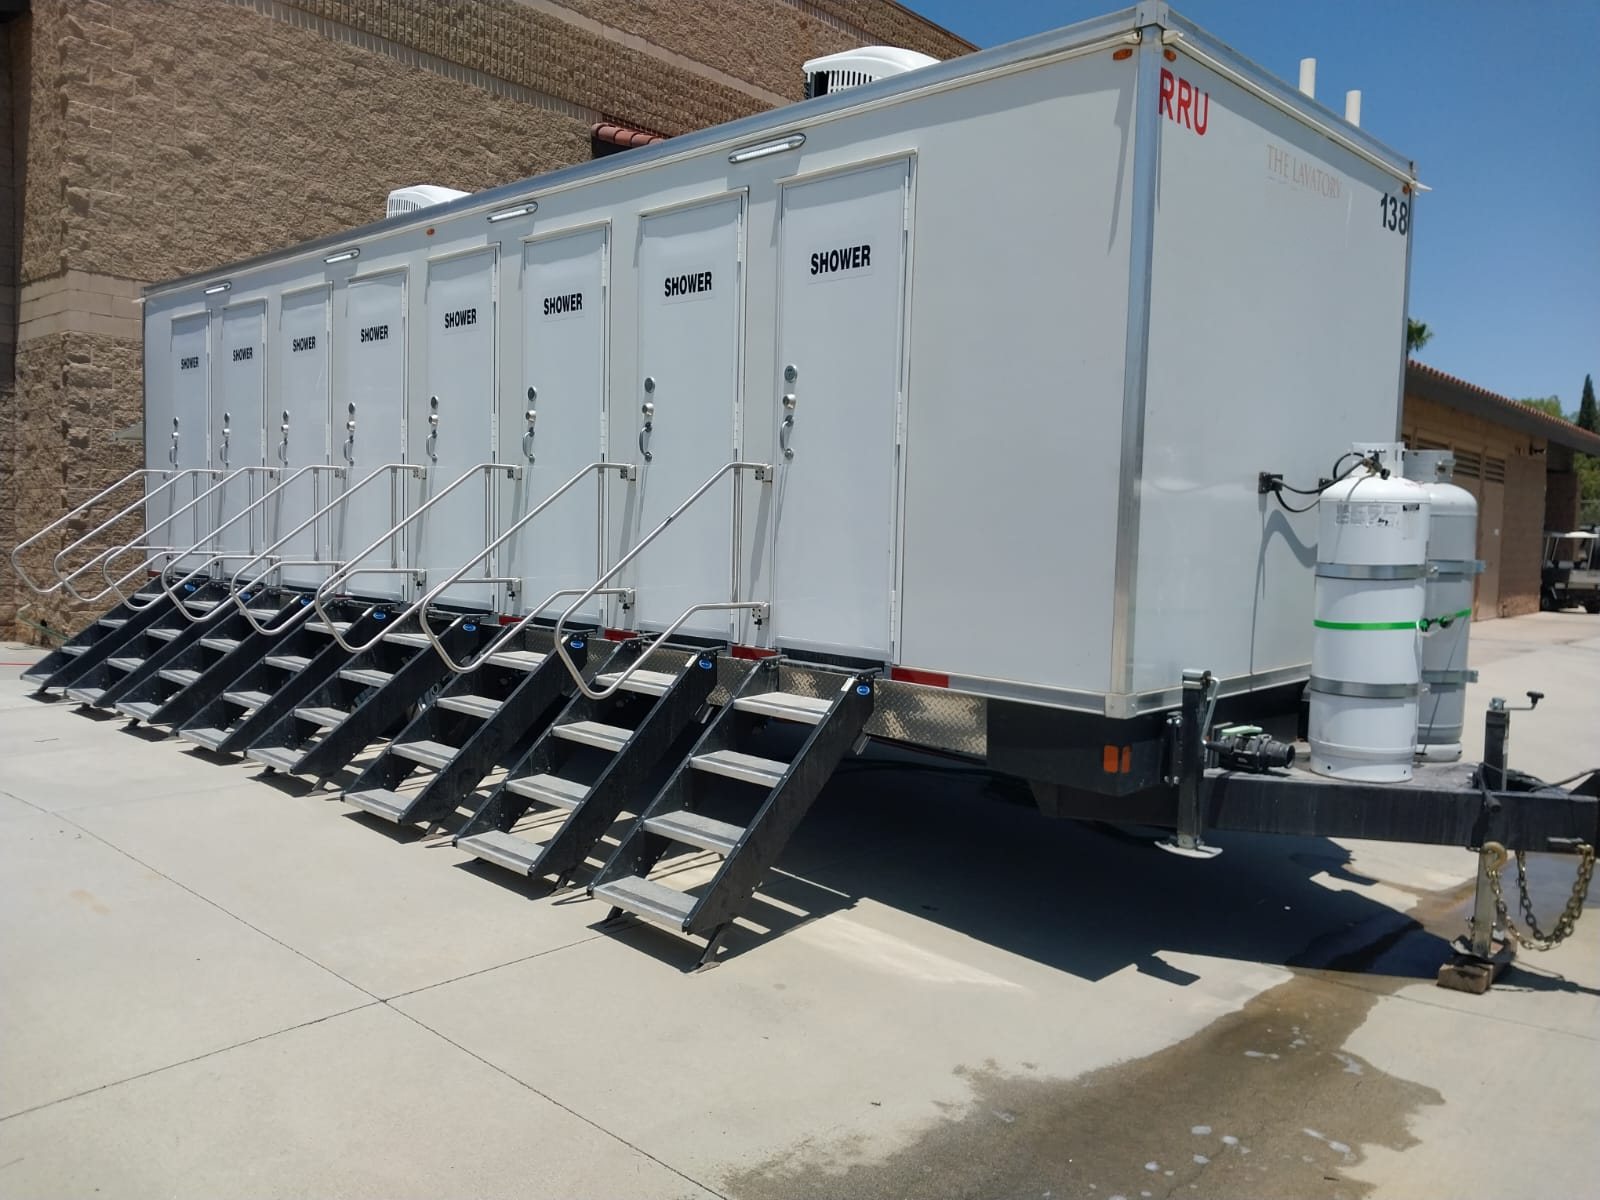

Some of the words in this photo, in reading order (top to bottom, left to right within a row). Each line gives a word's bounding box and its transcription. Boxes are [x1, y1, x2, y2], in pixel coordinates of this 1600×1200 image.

[1159, 67, 1209, 135] RRU
[1266, 143, 1289, 178] THE
[1292, 157, 1342, 199] LAVATORY
[1380, 192, 1408, 235] 138
[811, 244, 871, 276] SHOWER
[664, 271, 712, 298] SHOWER
[543, 292, 583, 316] SHOWER
[444, 307, 477, 329] SHOWER
[292, 335, 316, 352] SHOWER
[360, 324, 389, 343] SHOWER
[180, 356, 199, 371] SHOWER
[232, 346, 253, 362] SHOWER
